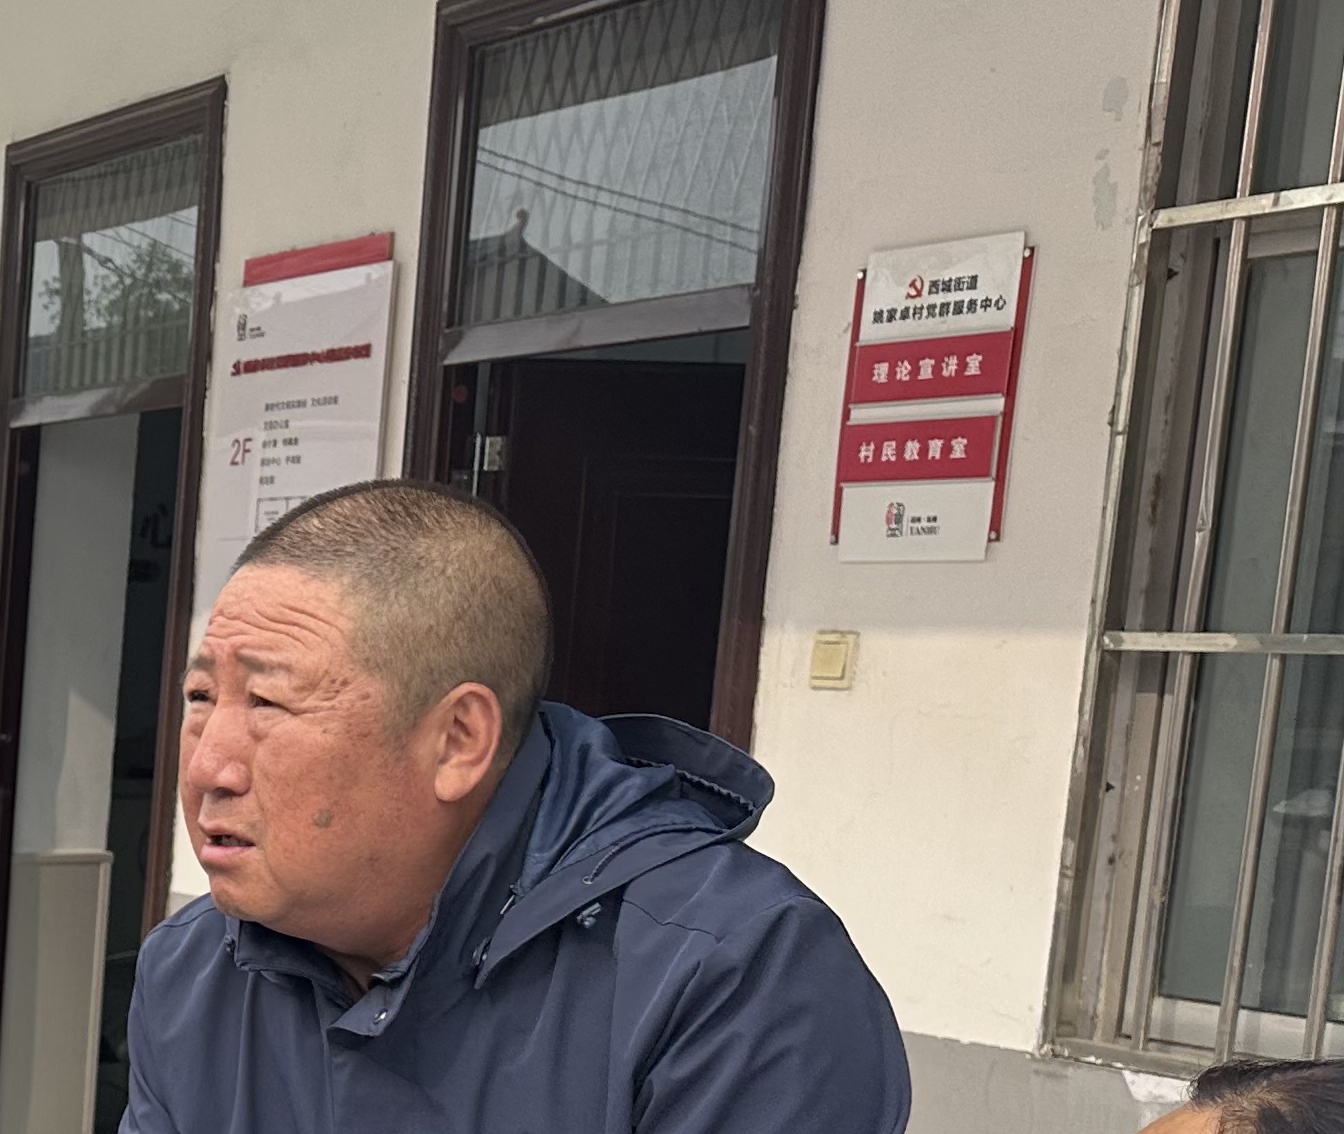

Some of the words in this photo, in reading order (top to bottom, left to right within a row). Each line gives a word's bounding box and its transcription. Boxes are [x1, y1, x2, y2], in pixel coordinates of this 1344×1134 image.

[928, 274, 979, 296] 西城街道
[871, 352, 983, 384] 理论宣讲室
[230, 437, 253, 467] 2F
[858, 436, 968, 464] 村民教育室
